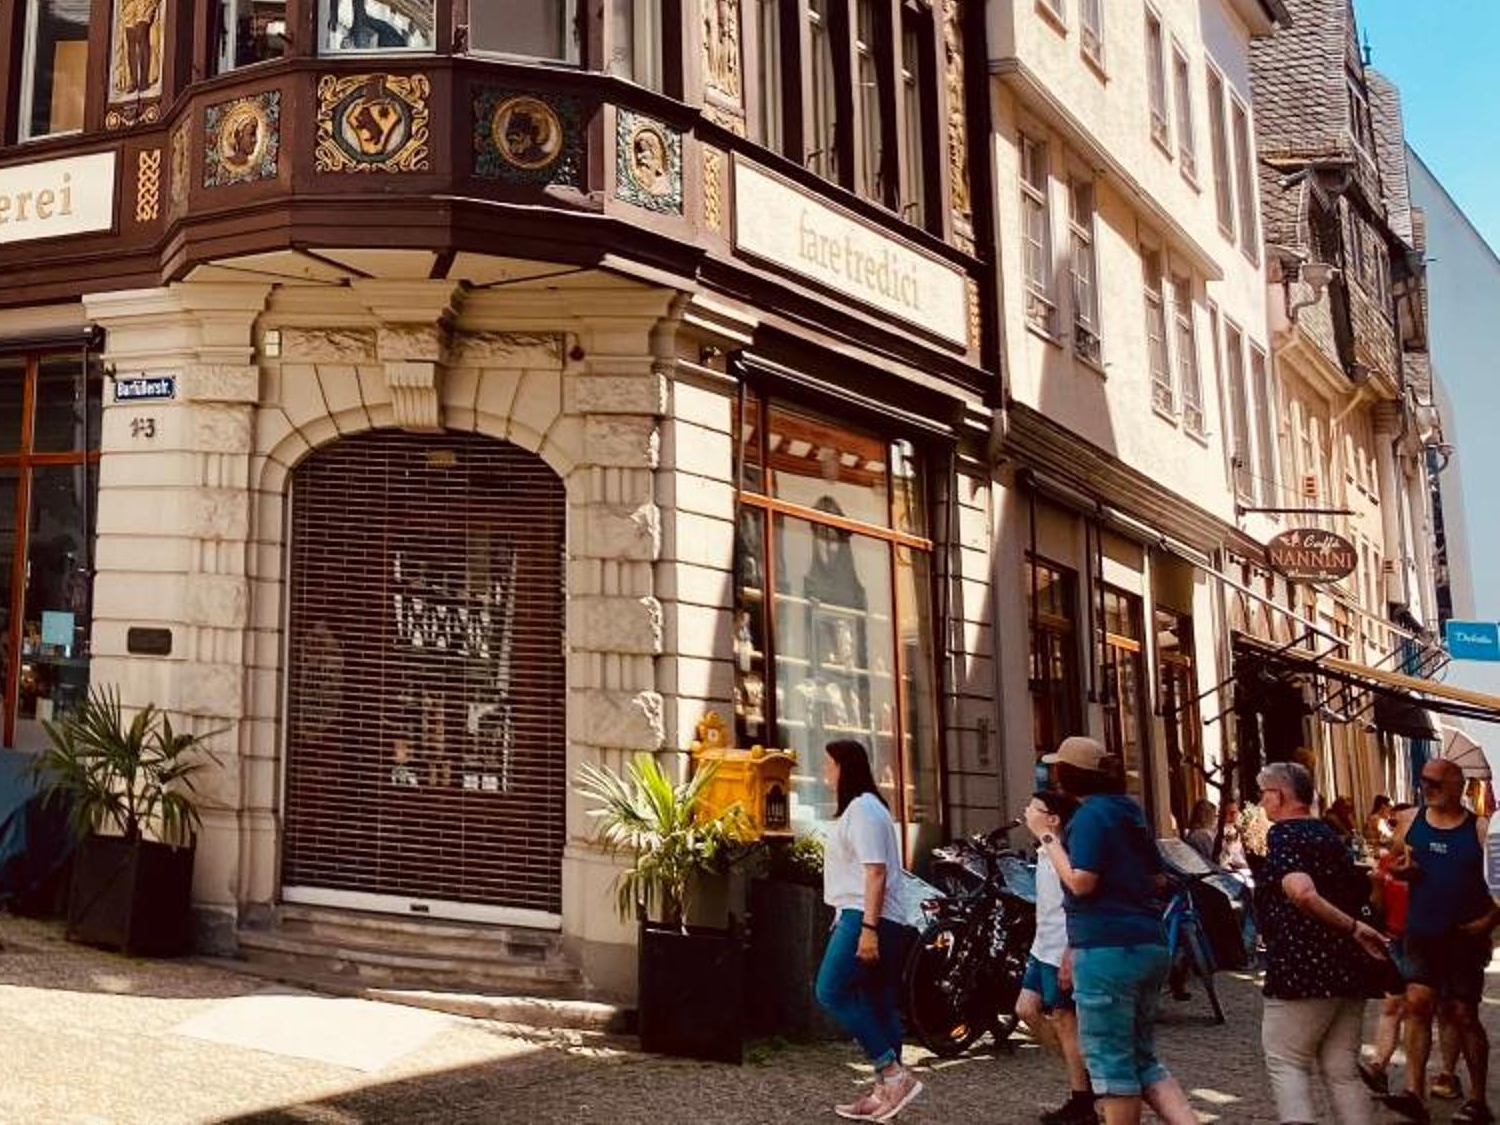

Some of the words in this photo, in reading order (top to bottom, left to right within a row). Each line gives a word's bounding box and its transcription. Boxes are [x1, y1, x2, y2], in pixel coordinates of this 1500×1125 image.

[799, 208, 841, 273] fare
[845, 234, 920, 311] tredici
[1270, 547, 1352, 569] NANNINI
